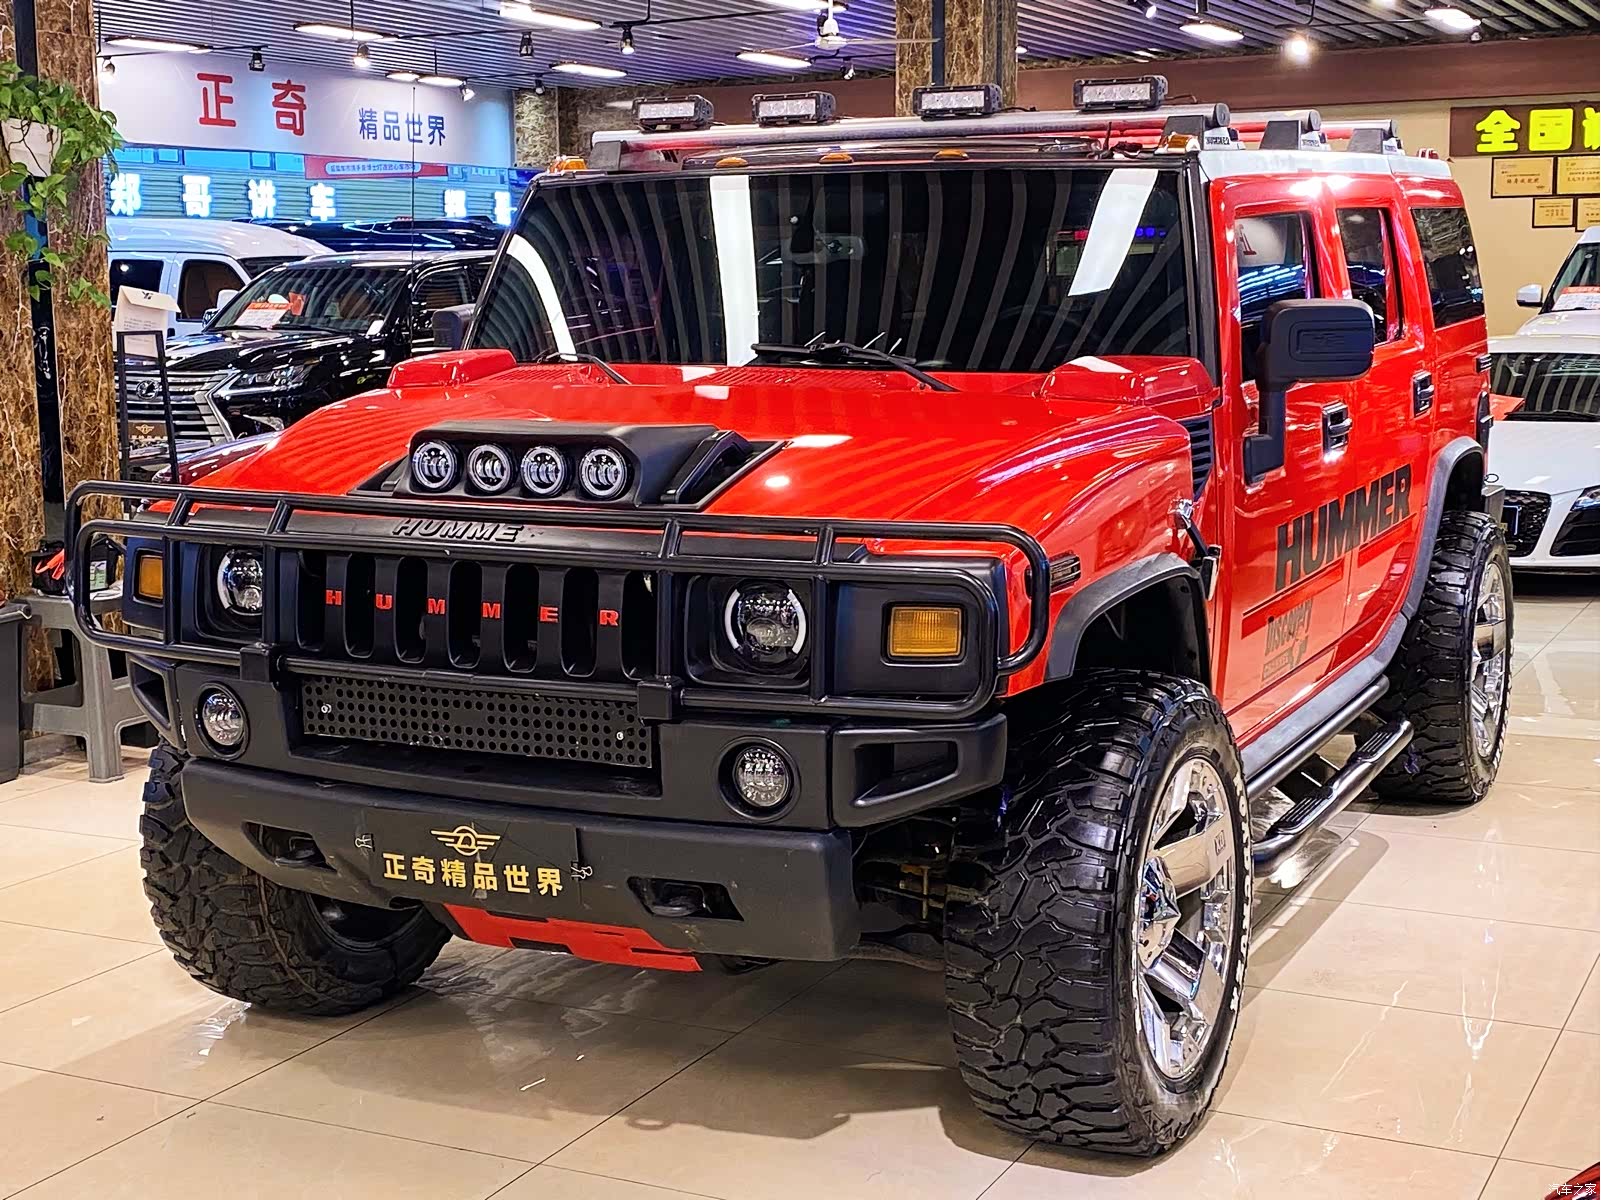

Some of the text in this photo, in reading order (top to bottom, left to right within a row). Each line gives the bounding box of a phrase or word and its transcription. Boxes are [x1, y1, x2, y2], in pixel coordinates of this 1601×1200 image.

[197, 72, 447, 146] 正奇 精品世界
[109, 172, 337, 222] 郑哥讲车
[392, 518, 534, 543] HUMME
[1275, 463, 1411, 593] HUMMER
[382, 852, 563, 897] 正奇精品世界
